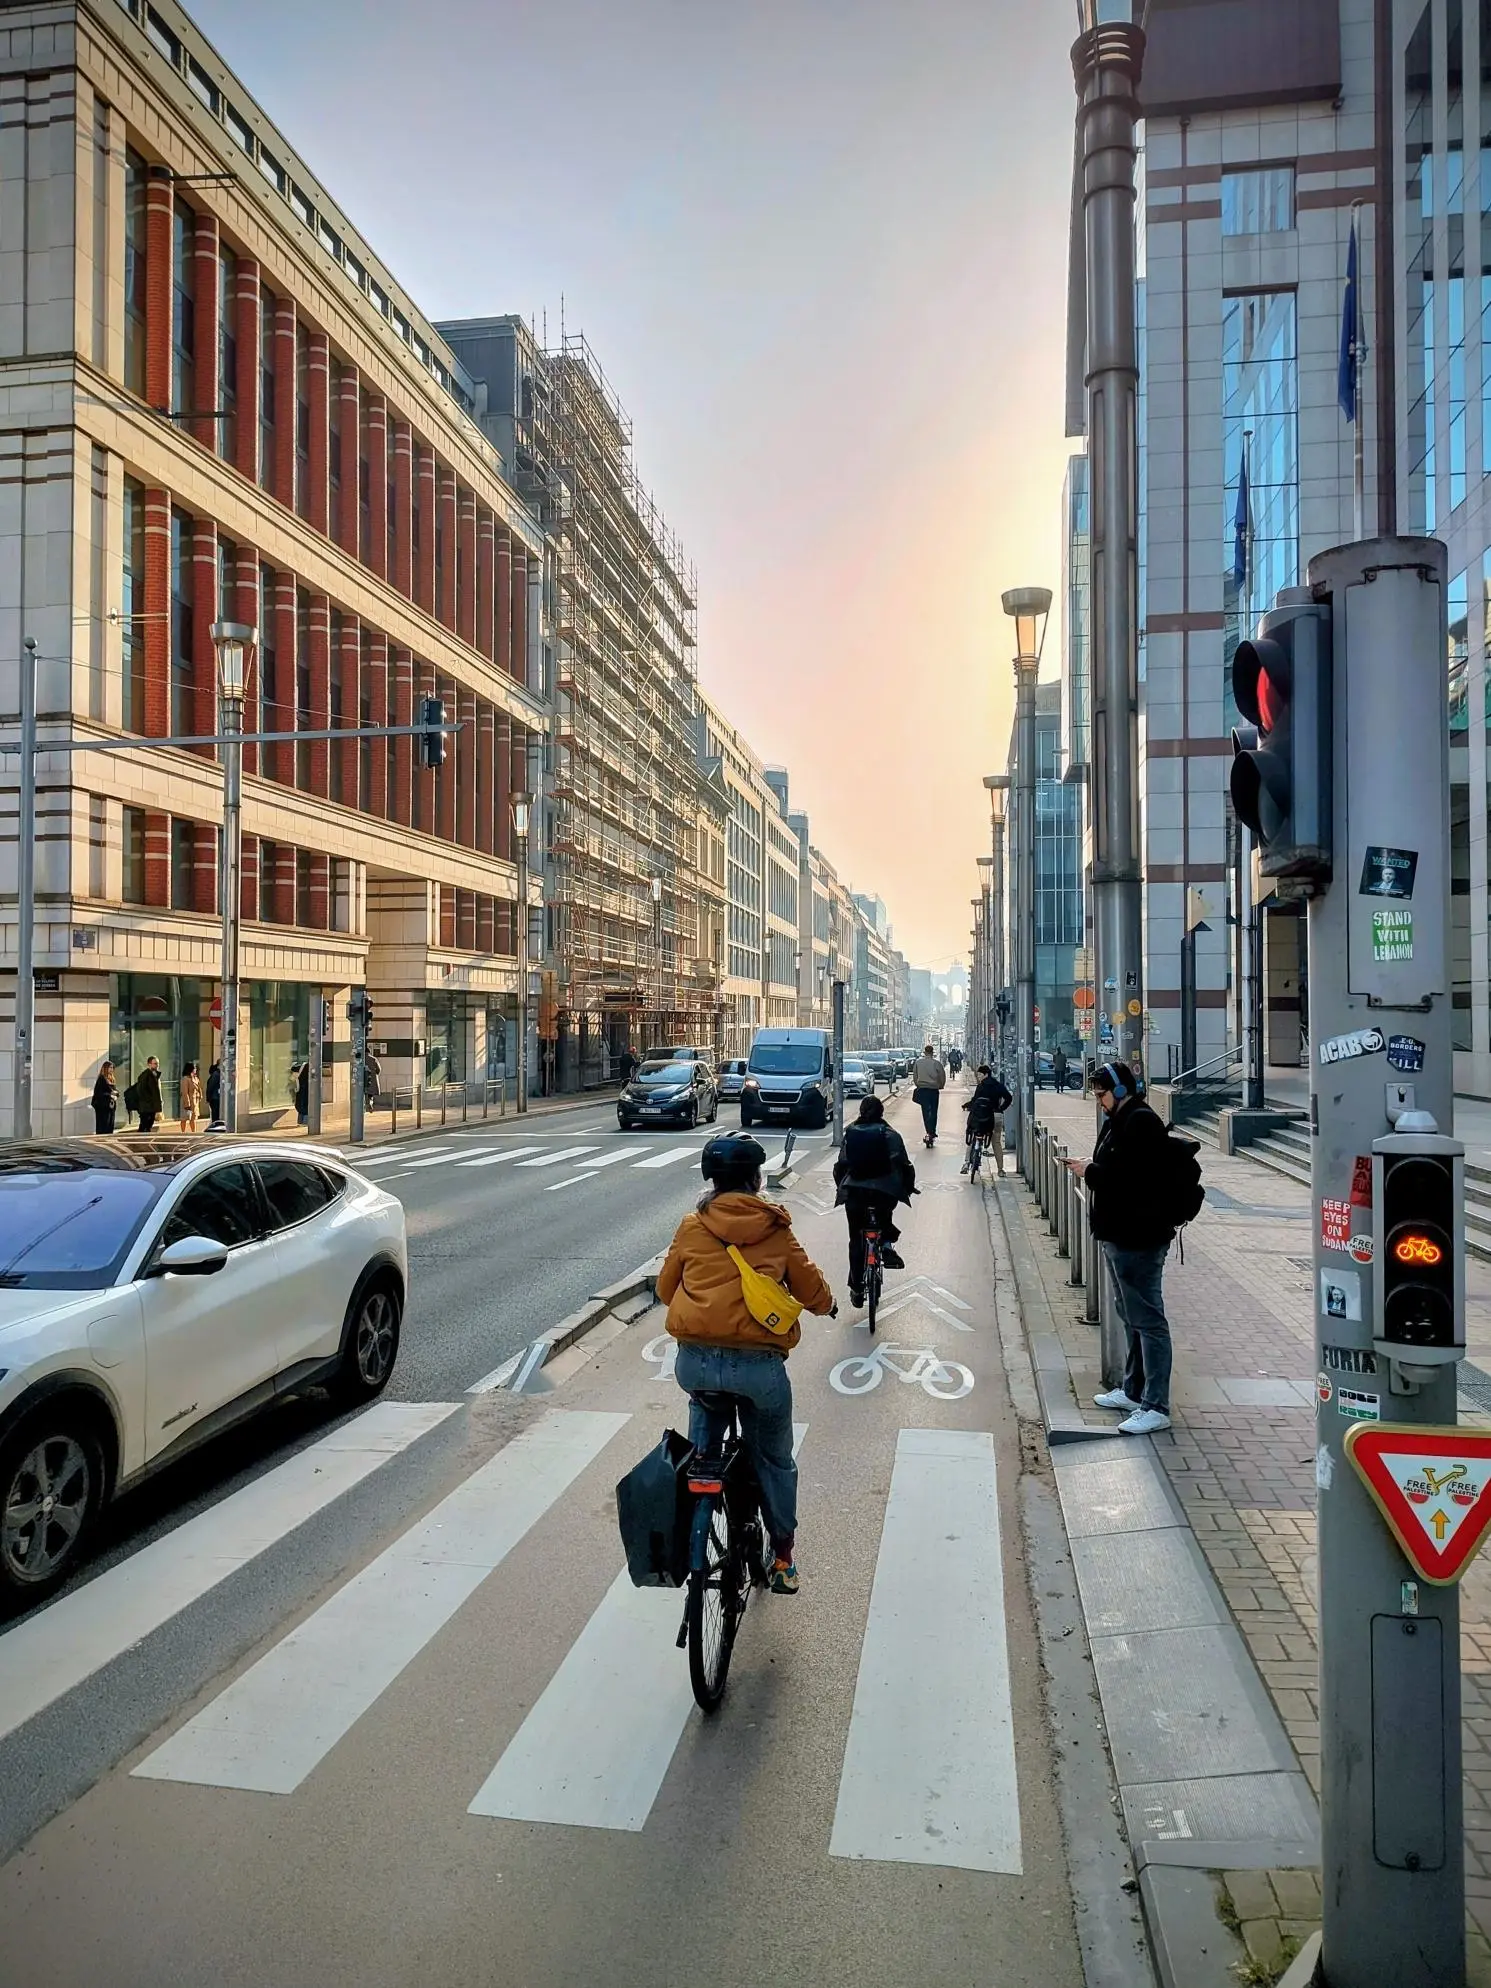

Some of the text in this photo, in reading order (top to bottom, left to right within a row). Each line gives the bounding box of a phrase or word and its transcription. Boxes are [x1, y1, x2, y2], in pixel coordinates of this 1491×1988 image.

[1372, 856, 1411, 868] WANTED
[1373, 911, 1412, 926] STAND
[1377, 929, 1409, 942] WITH
[1374, 944, 1413, 961] LEBANON
[1320, 1037, 1363, 1064] ACAB
[1390, 1042, 1422, 1052] BORDERS
[1322, 1198, 1351, 1213] KEEP
[1324, 1212, 1349, 1226] EYES
[1327, 1225, 1342, 1237] ON
[1322, 1235, 1350, 1251] SUDAN
[1322, 1345, 1376, 1374] FURIA
[1403, 1486, 1434, 1496] PALESTINE
[1407, 1479, 1432, 1490] FREE
[1452, 1481, 1477, 1492] FREE
[1448, 1488, 1479, 1497] PALESTINE
